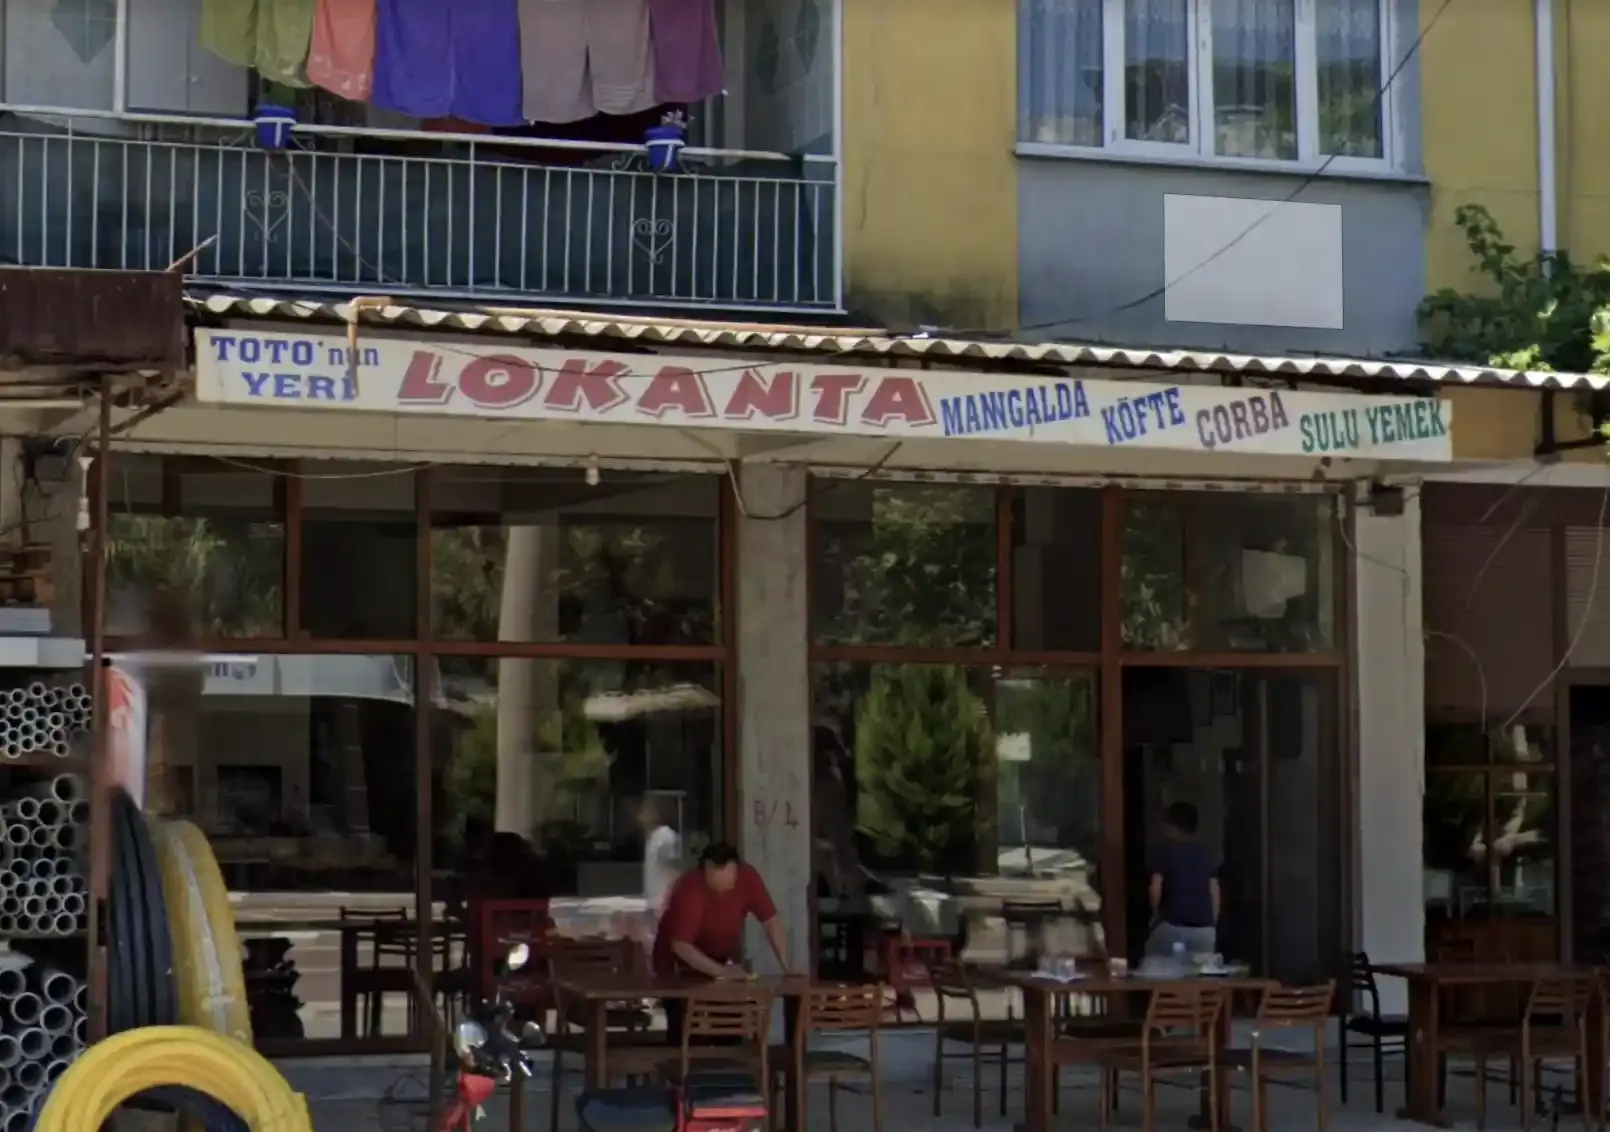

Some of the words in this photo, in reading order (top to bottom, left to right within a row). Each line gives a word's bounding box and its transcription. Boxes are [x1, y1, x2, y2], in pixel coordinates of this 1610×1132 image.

[397, 350, 937, 427] LOKANTA
[1100, 387, 1185, 444] KÖFTE
[1300, 408, 1359, 453] SULU
[1366, 400, 1447, 444] YEMEK
